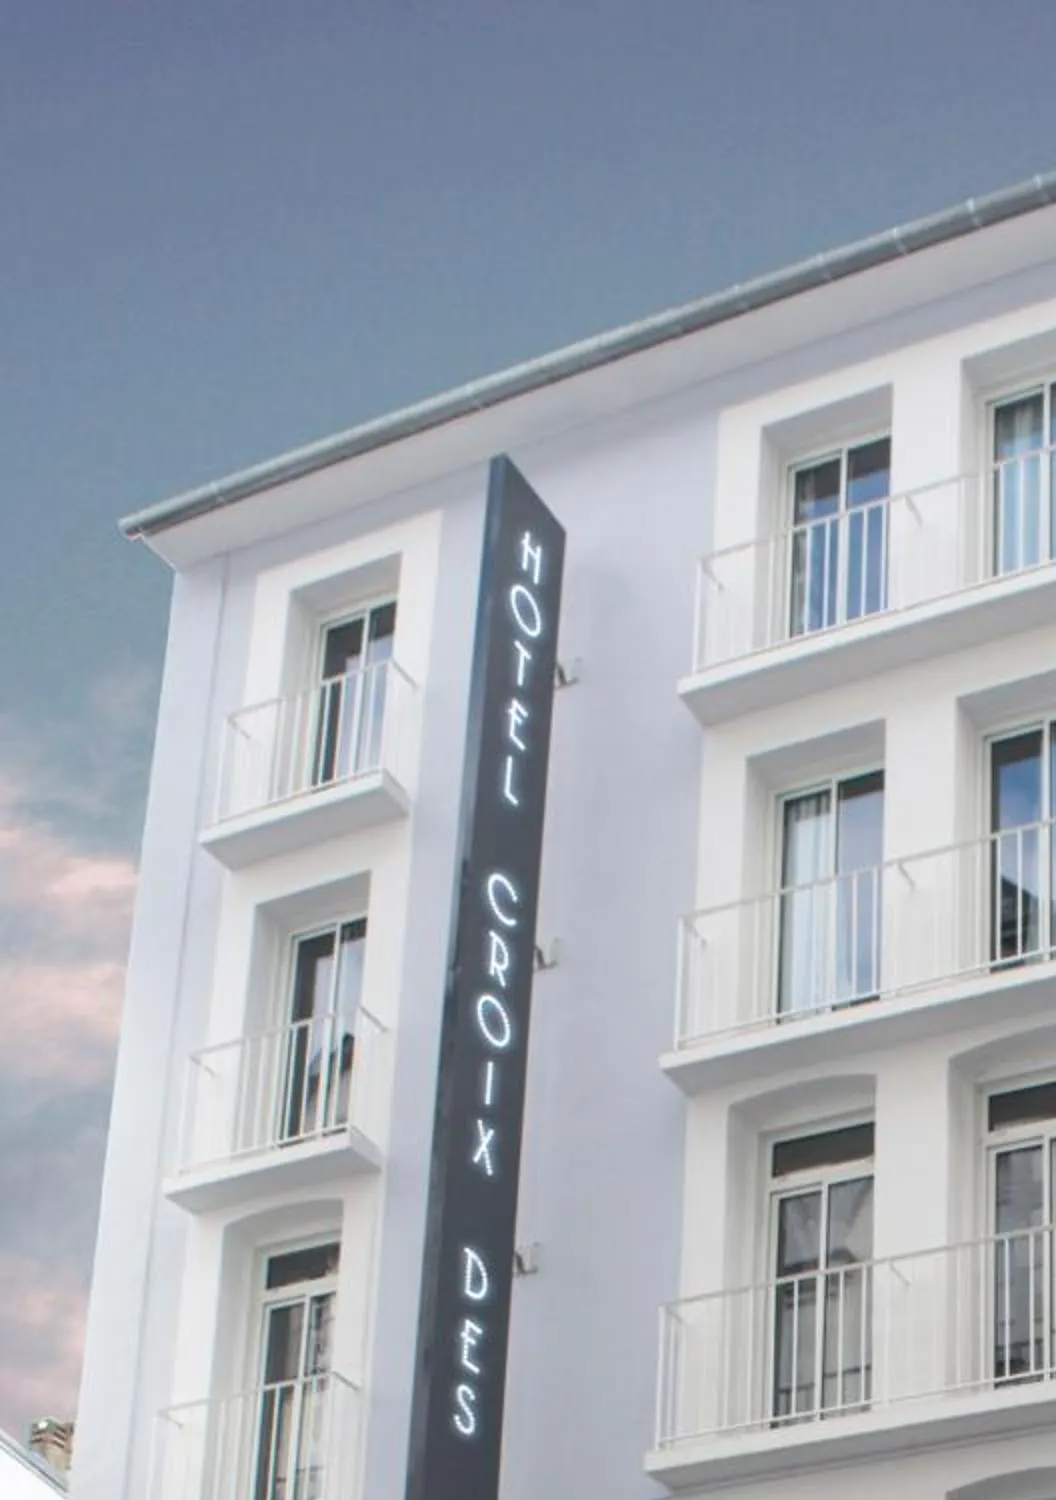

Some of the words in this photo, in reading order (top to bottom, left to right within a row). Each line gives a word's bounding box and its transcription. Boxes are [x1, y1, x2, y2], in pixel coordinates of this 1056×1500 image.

[503, 530, 543, 806] HOTEL
[472, 872, 518, 1186] CROIX
[453, 1247, 489, 1436] DES
